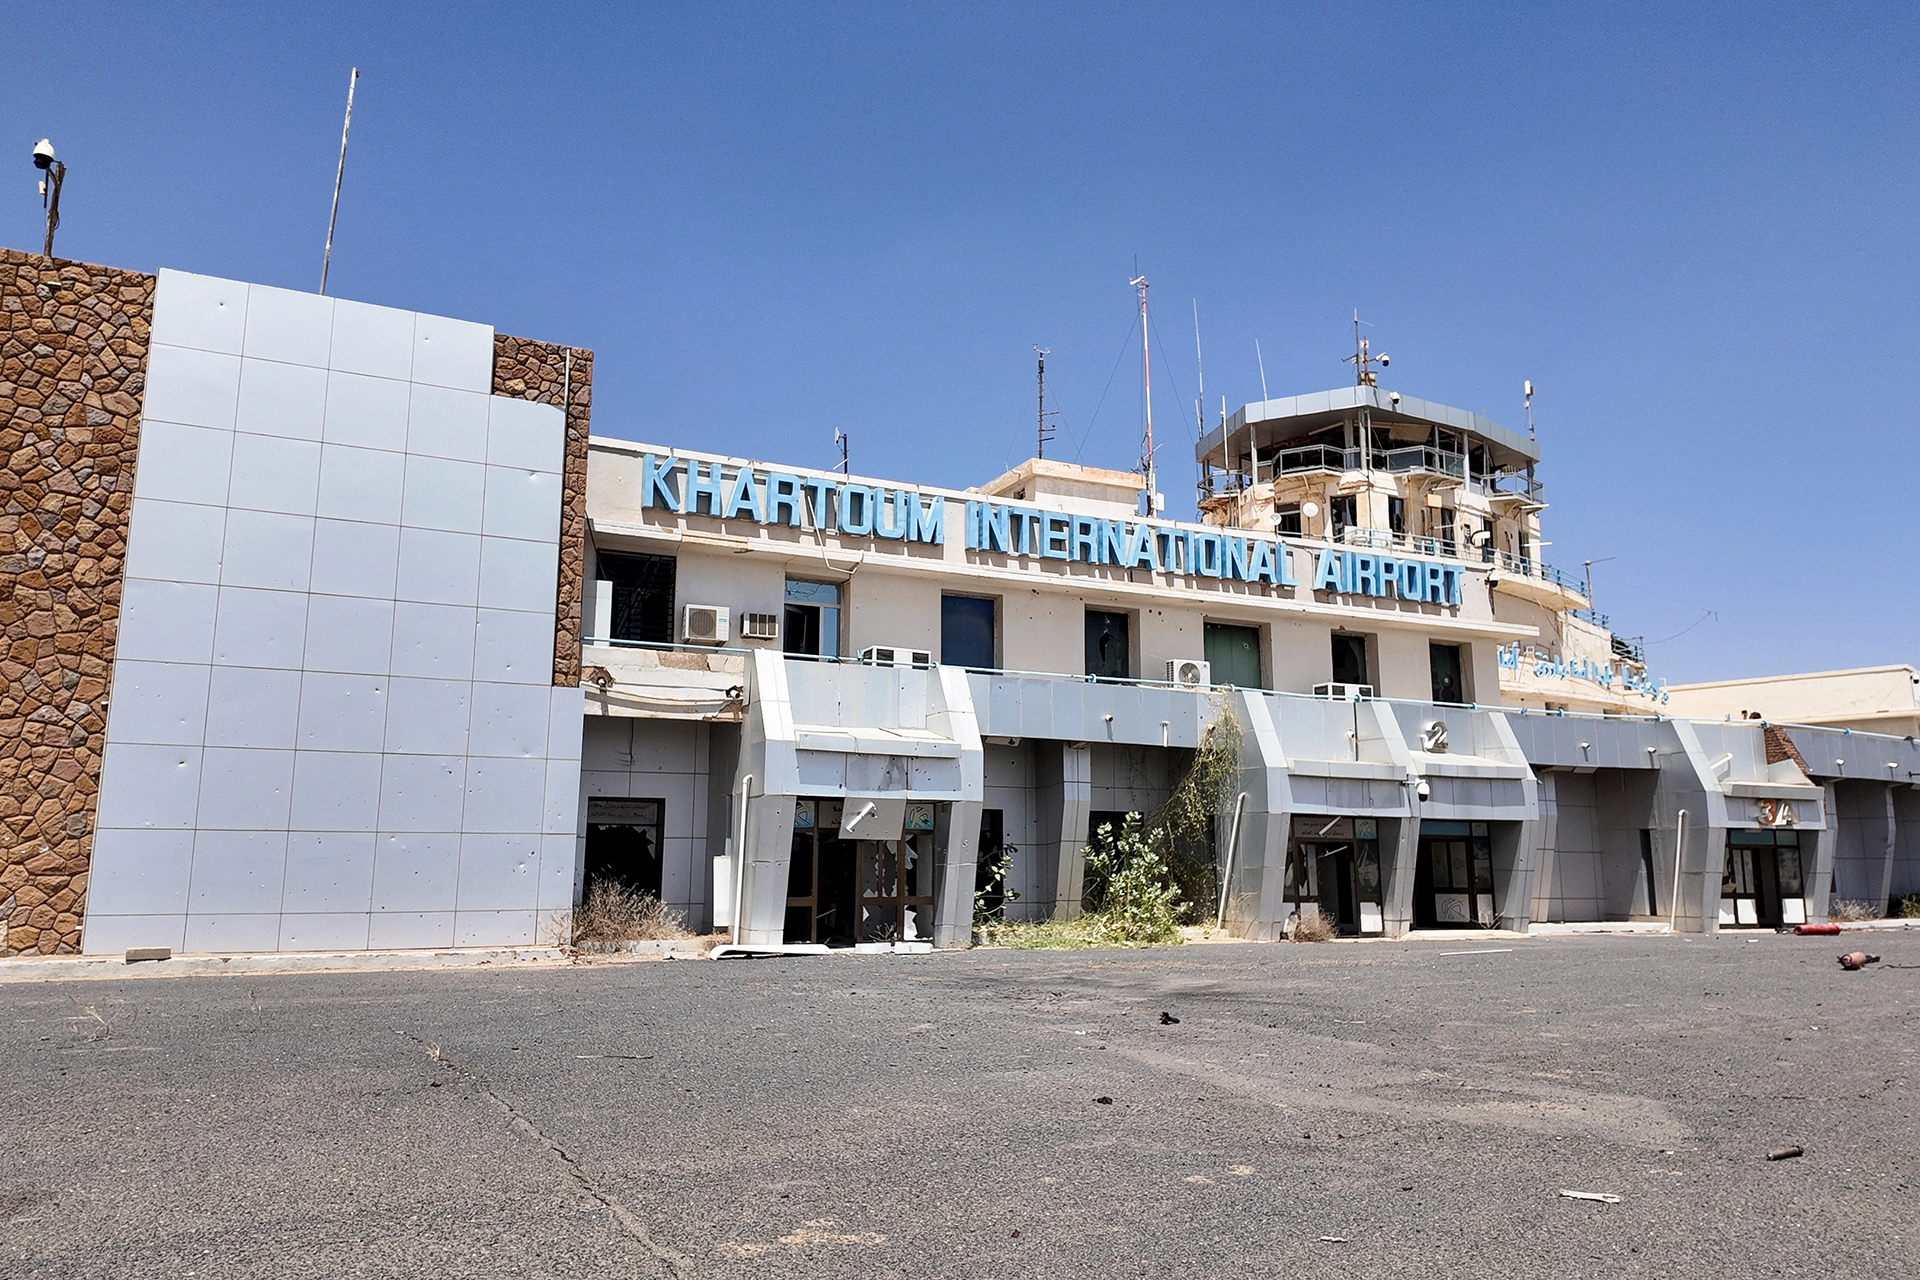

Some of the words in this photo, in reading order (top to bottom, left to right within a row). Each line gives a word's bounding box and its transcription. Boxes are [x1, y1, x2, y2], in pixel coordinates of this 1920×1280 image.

[642, 454, 944, 545] KHARTOUM
[966, 501, 1298, 586] INTERNATIONAL
[1314, 549, 1466, 606] AIRPORT
[1420, 721, 1448, 753] 2
